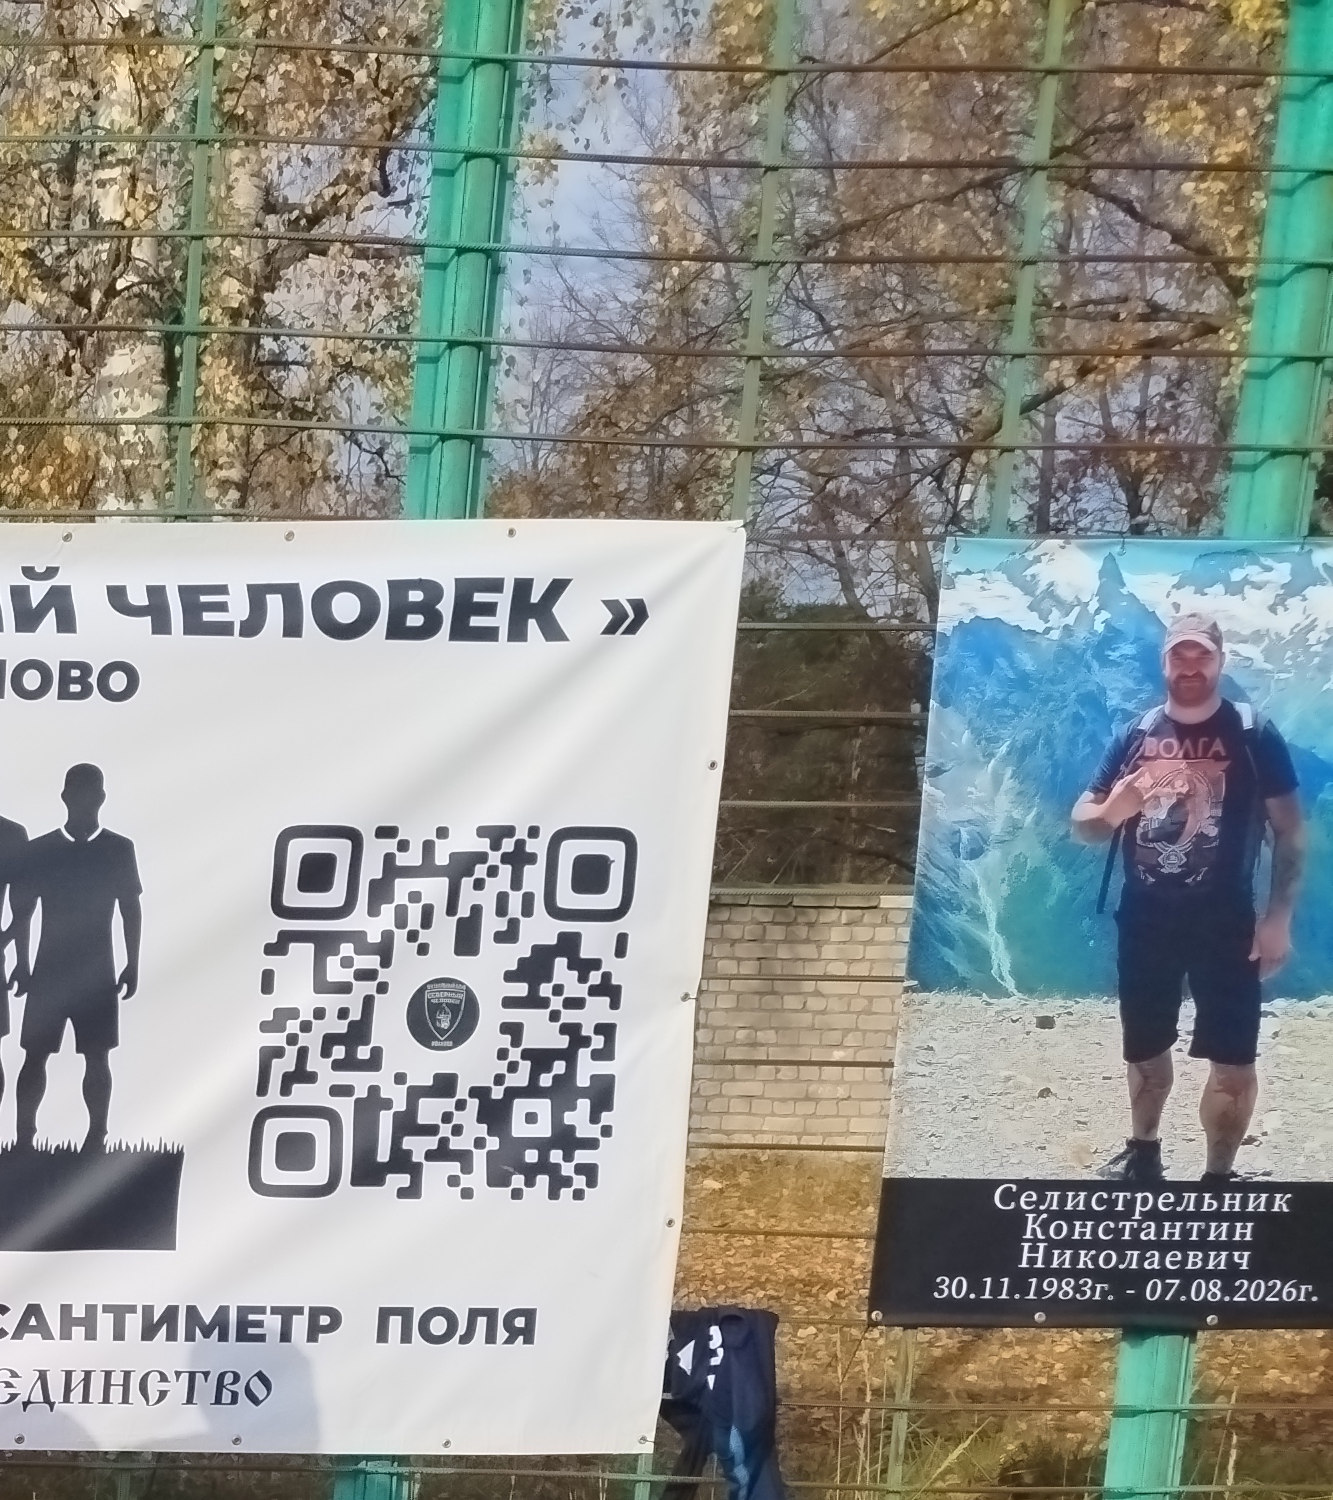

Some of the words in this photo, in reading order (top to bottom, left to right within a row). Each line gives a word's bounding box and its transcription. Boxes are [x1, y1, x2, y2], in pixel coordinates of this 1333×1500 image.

[106, 577, 573, 643] ЧЕЛОВЕК
[994, 1184, 1292, 1219] Селистрельник
[1022, 1213, 1255, 1241] Константин
[1017, 1242, 1252, 1270] Николаевич
[933, 1276, 1114, 1302] 30.11.1983г.
[1145, 1279, 1319, 1302] 07.08.2026г.
[376, 1306, 538, 1346] ПОЛЯ
